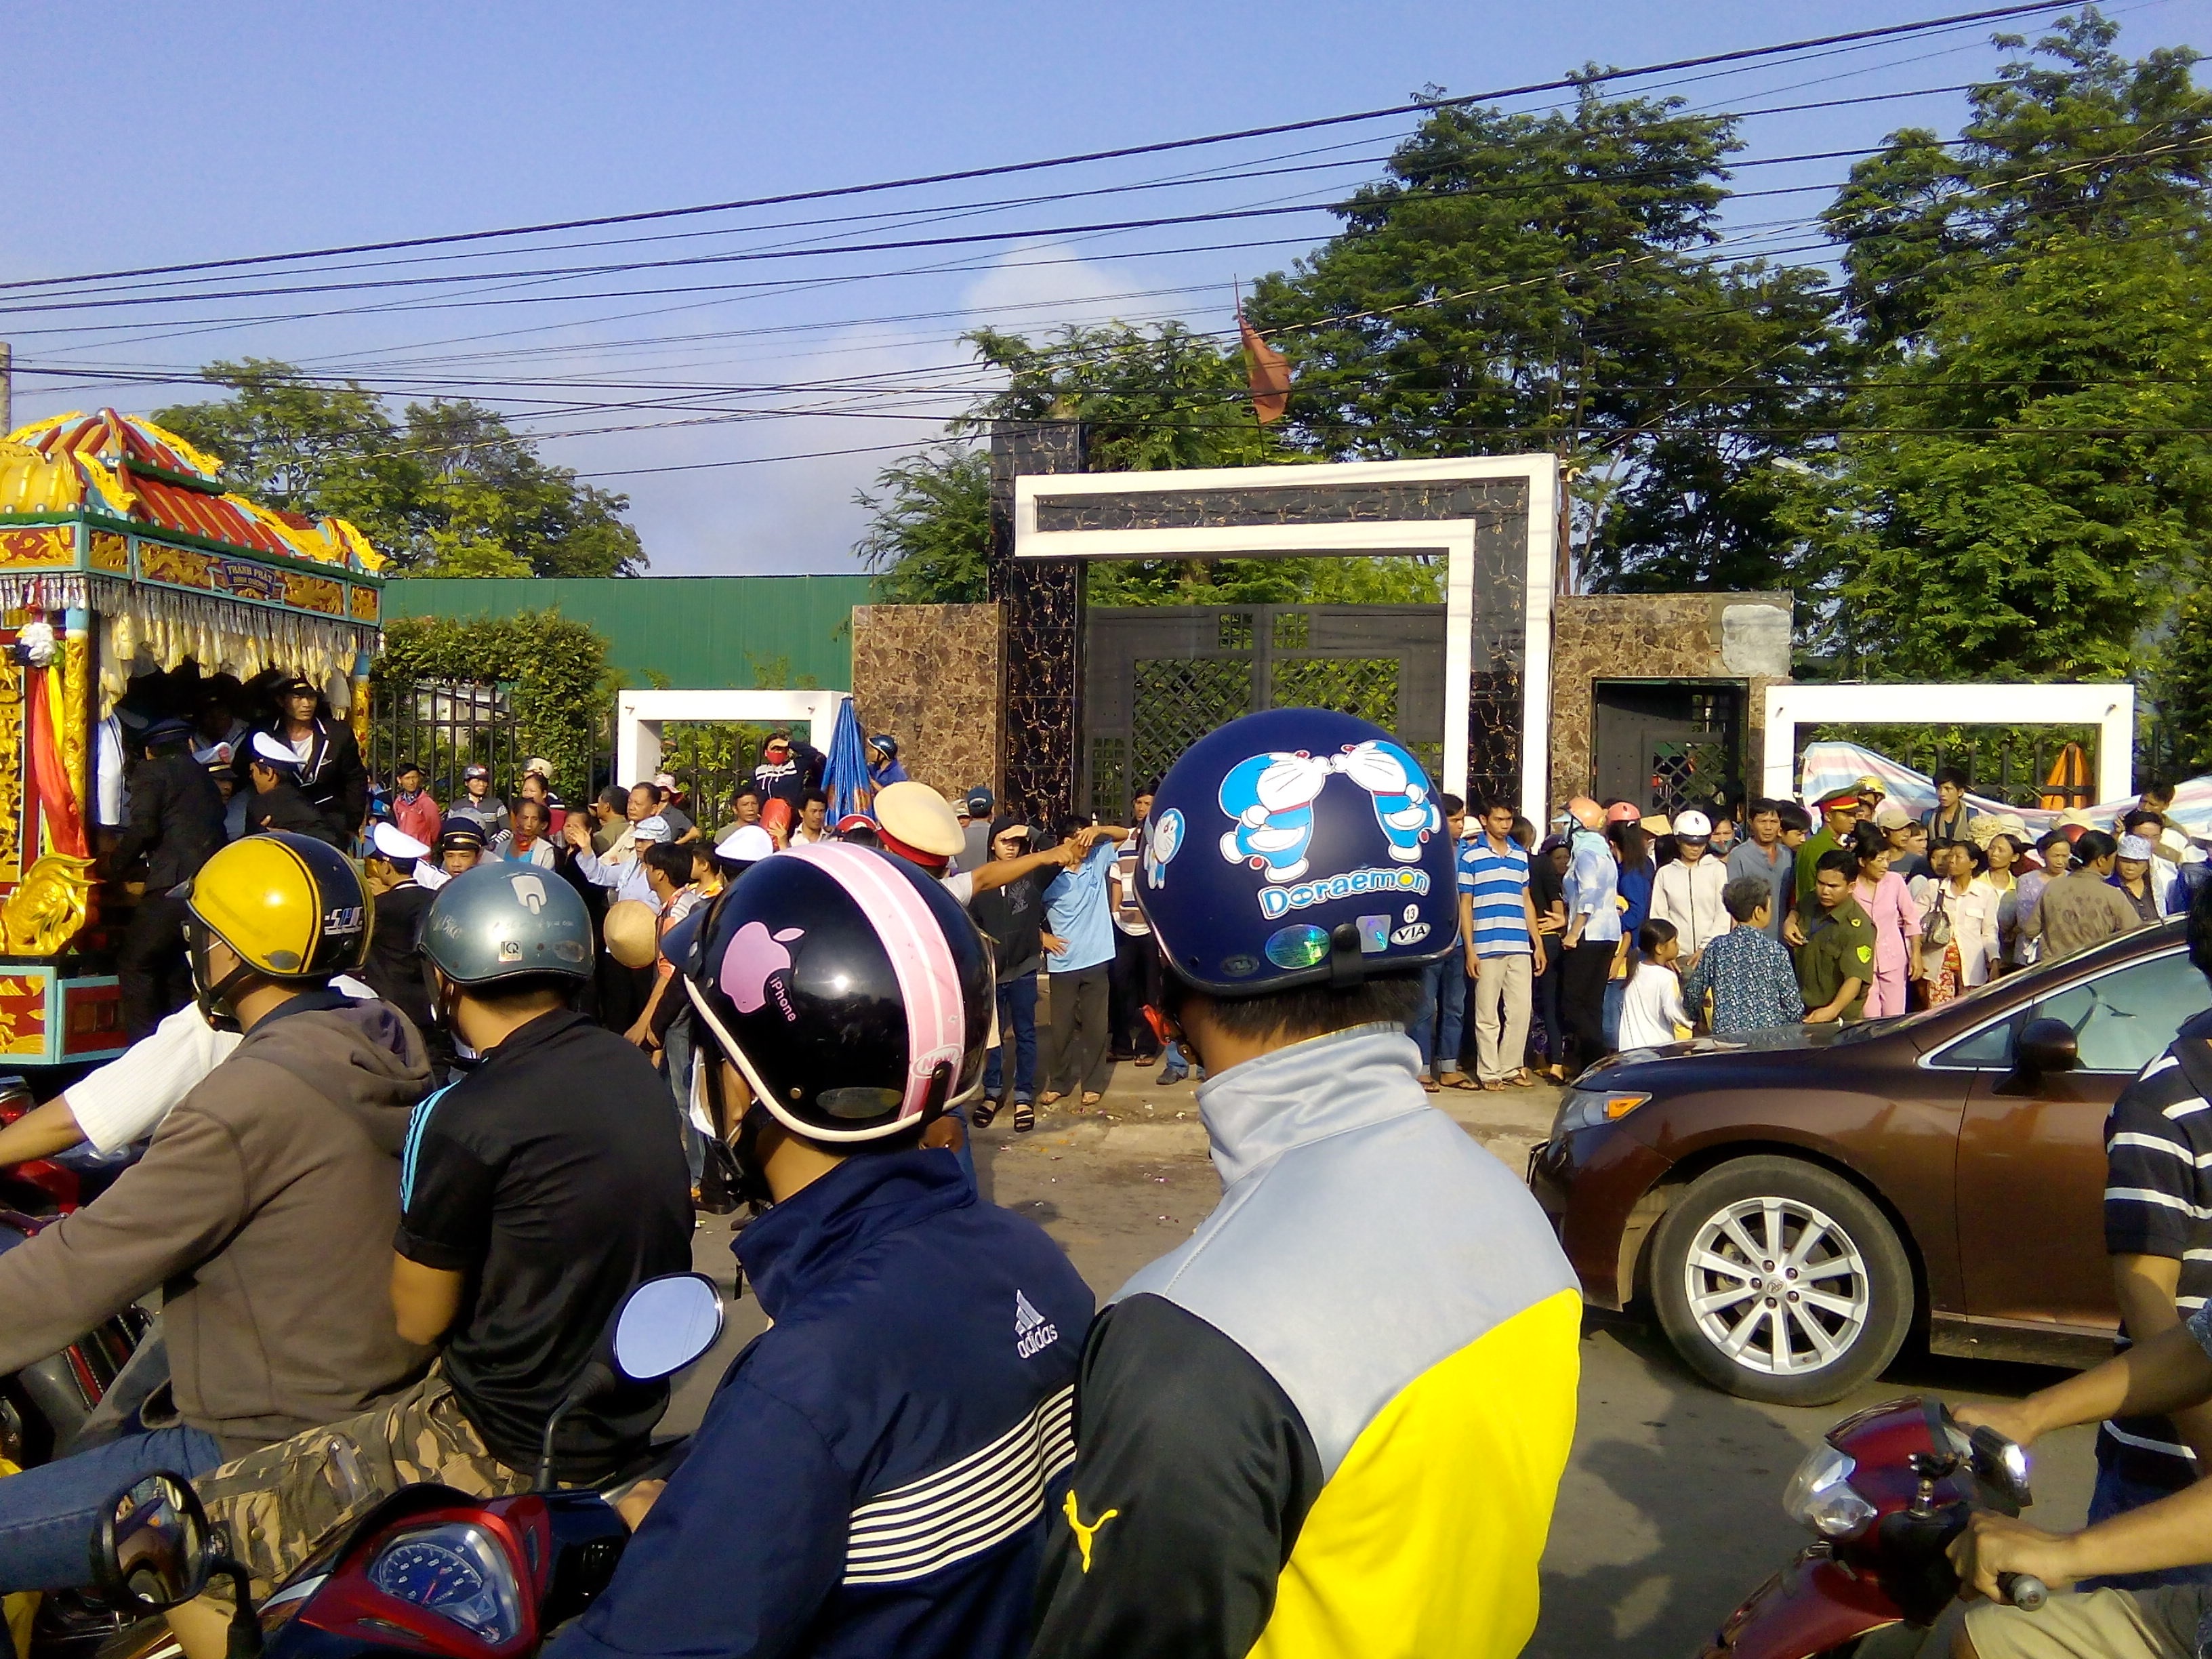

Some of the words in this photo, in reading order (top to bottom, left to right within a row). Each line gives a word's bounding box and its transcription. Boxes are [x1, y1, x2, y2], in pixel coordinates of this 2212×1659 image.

[1261, 867, 1430, 917] Doraemon
[1406, 908, 1415, 920] 13
[1397, 925, 1426, 940] VIA
[770, 977, 796, 1021] iPhone
[1017, 1324, 1058, 1358] adidas
